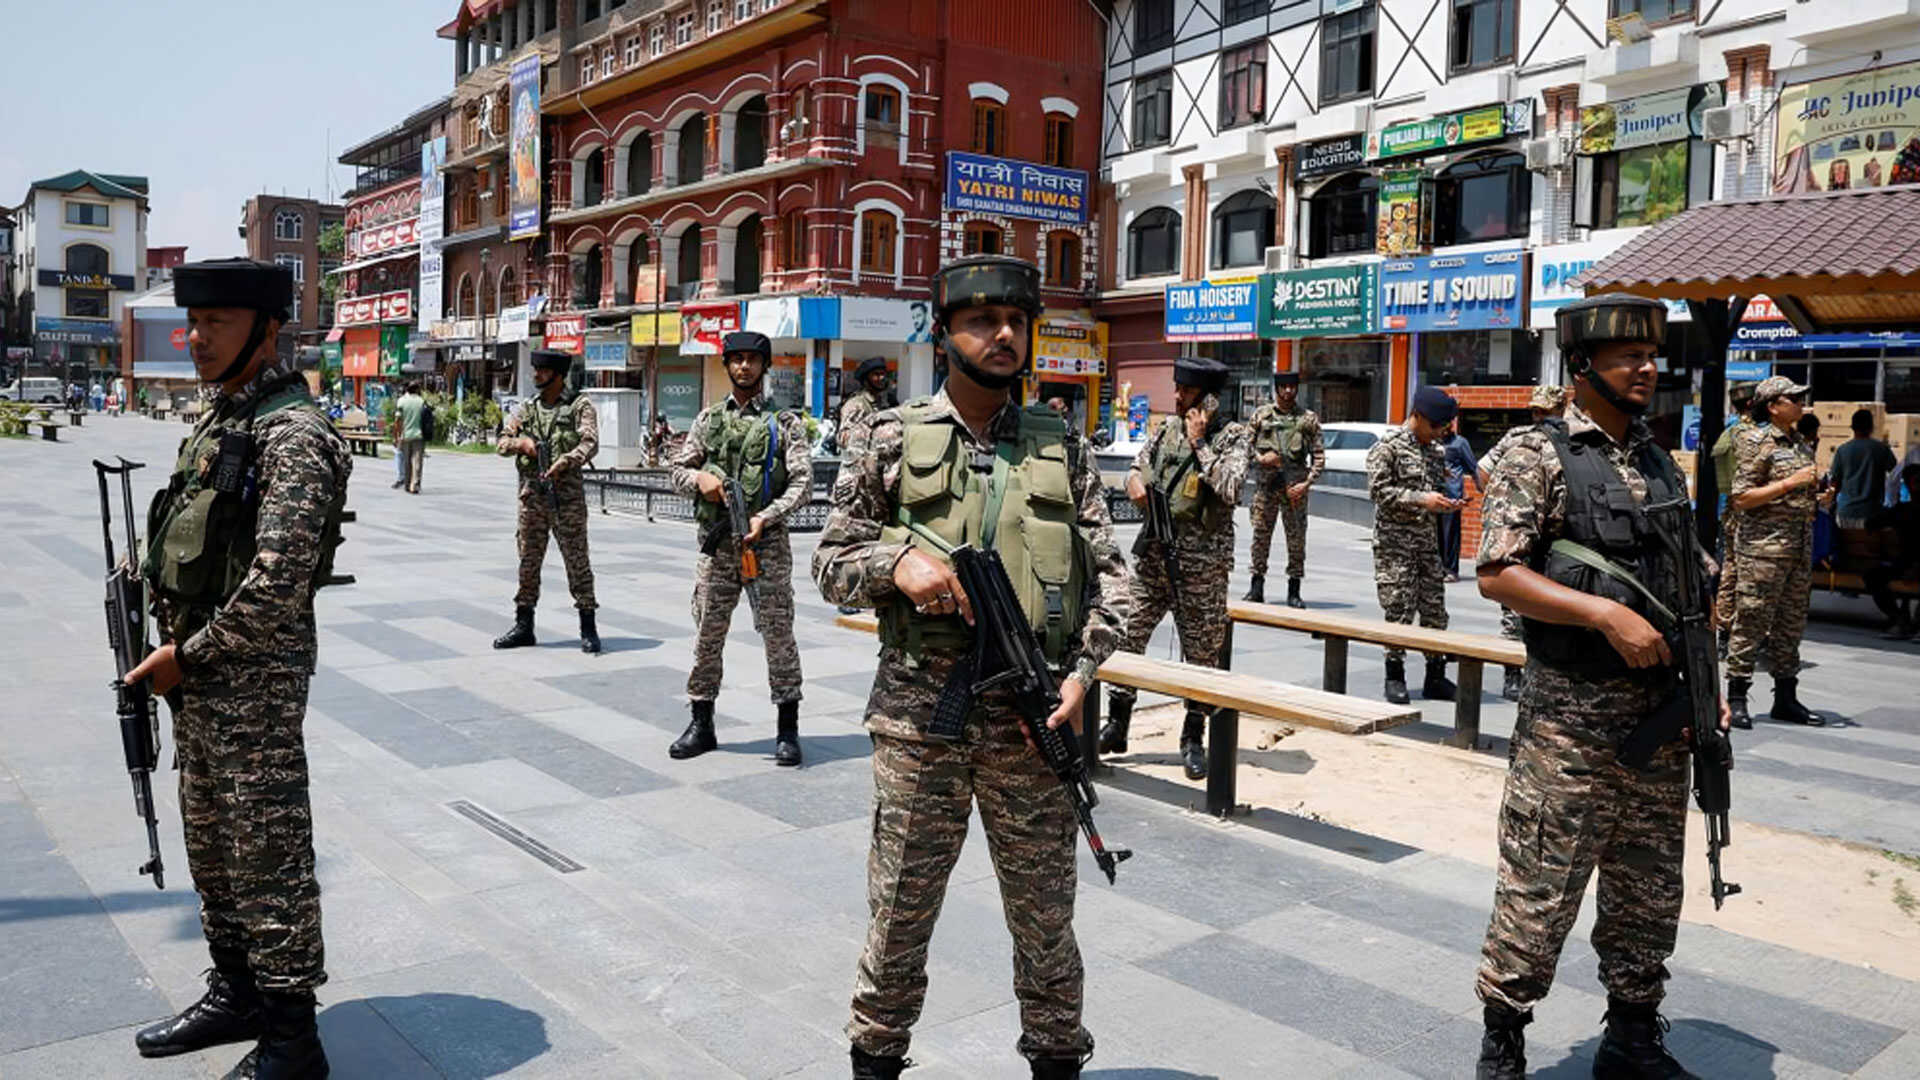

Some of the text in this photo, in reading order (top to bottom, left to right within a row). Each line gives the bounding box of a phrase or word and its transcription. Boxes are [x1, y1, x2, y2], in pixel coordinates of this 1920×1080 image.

[1619, 111, 1684, 136] Juniper
[1301, 150, 1363, 170] EDUCATION
[954, 160, 1083, 193] यात्री निवास
[958, 179, 1081, 209] YATRI NIWAS
[1170, 286, 1252, 310] FIDA HOISERY
[1295, 276, 1361, 300] DESTINY
[1366, 265, 1374, 332] STORES
[1384, 274, 1516, 307] TIME N SOUND
